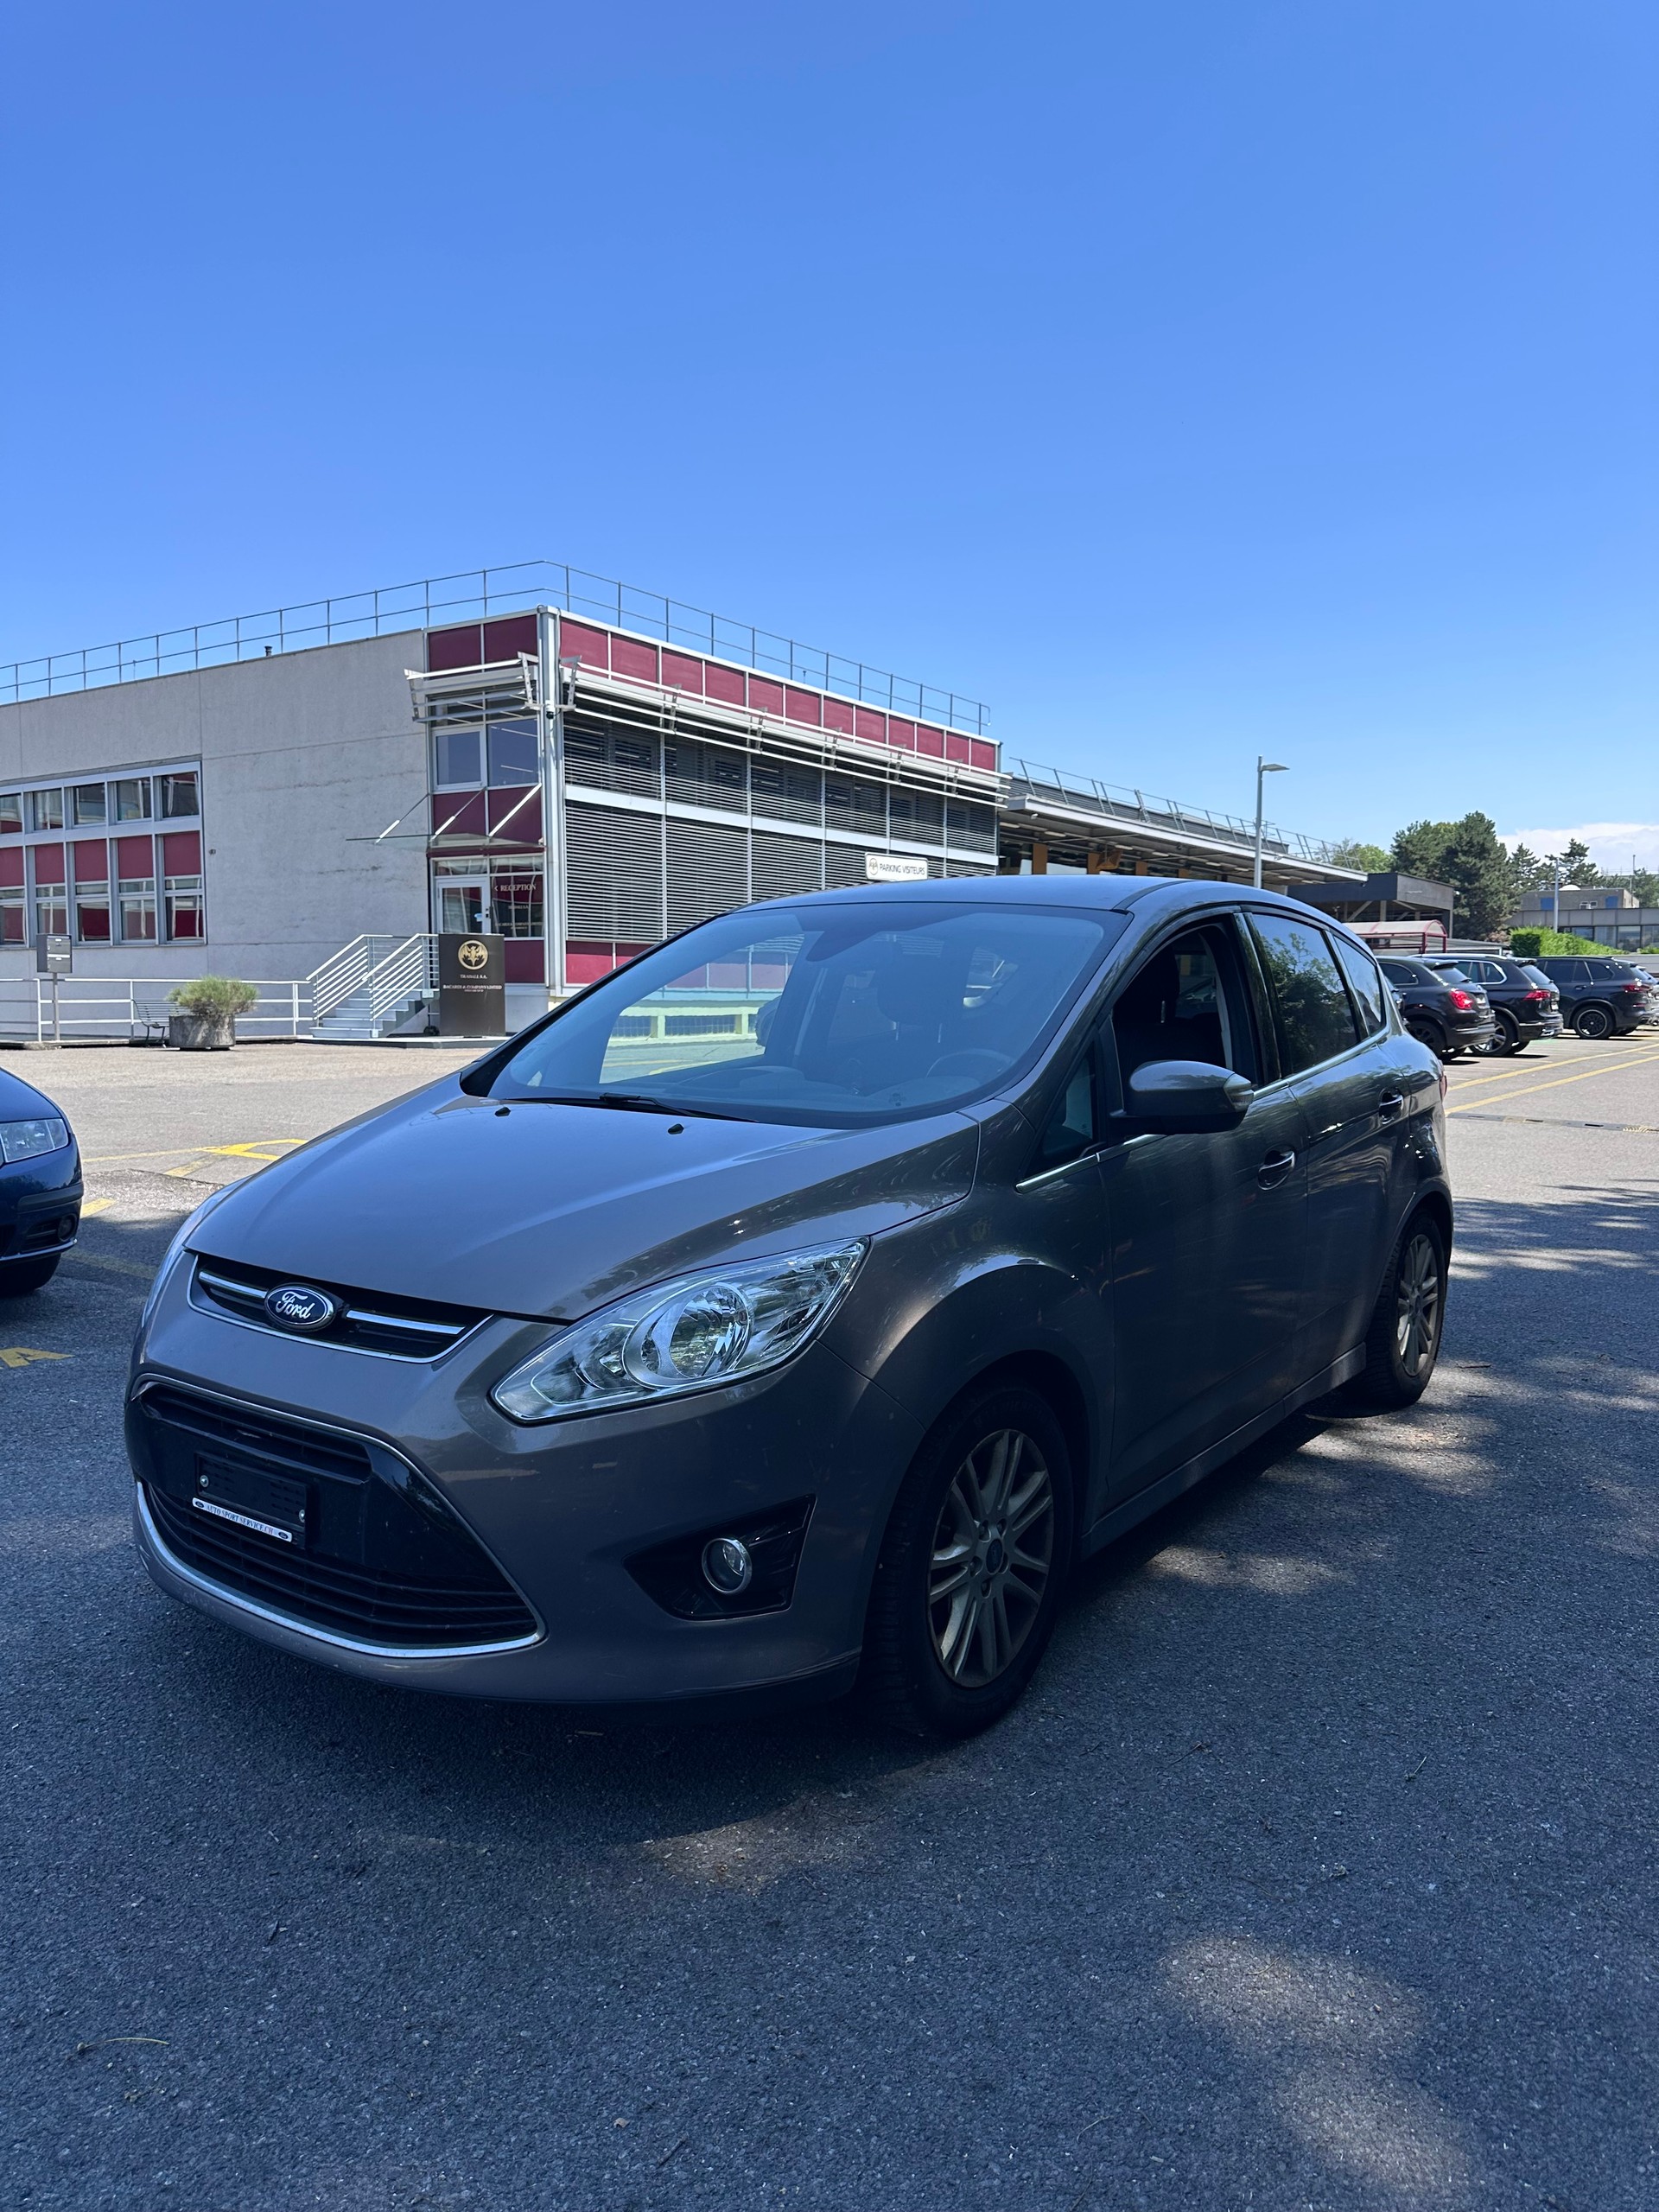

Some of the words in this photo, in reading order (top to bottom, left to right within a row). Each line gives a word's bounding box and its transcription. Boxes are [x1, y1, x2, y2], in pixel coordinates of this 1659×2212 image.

[880, 863, 901, 874] PARKING
[902, 865, 925, 875] VISITEURS
[500, 883, 537, 892] RECEPTION
[275, 1291, 315, 1319] Ford
[207, 1504, 222, 1516] AUTO
[221, 1510, 240, 1522] SPORT
